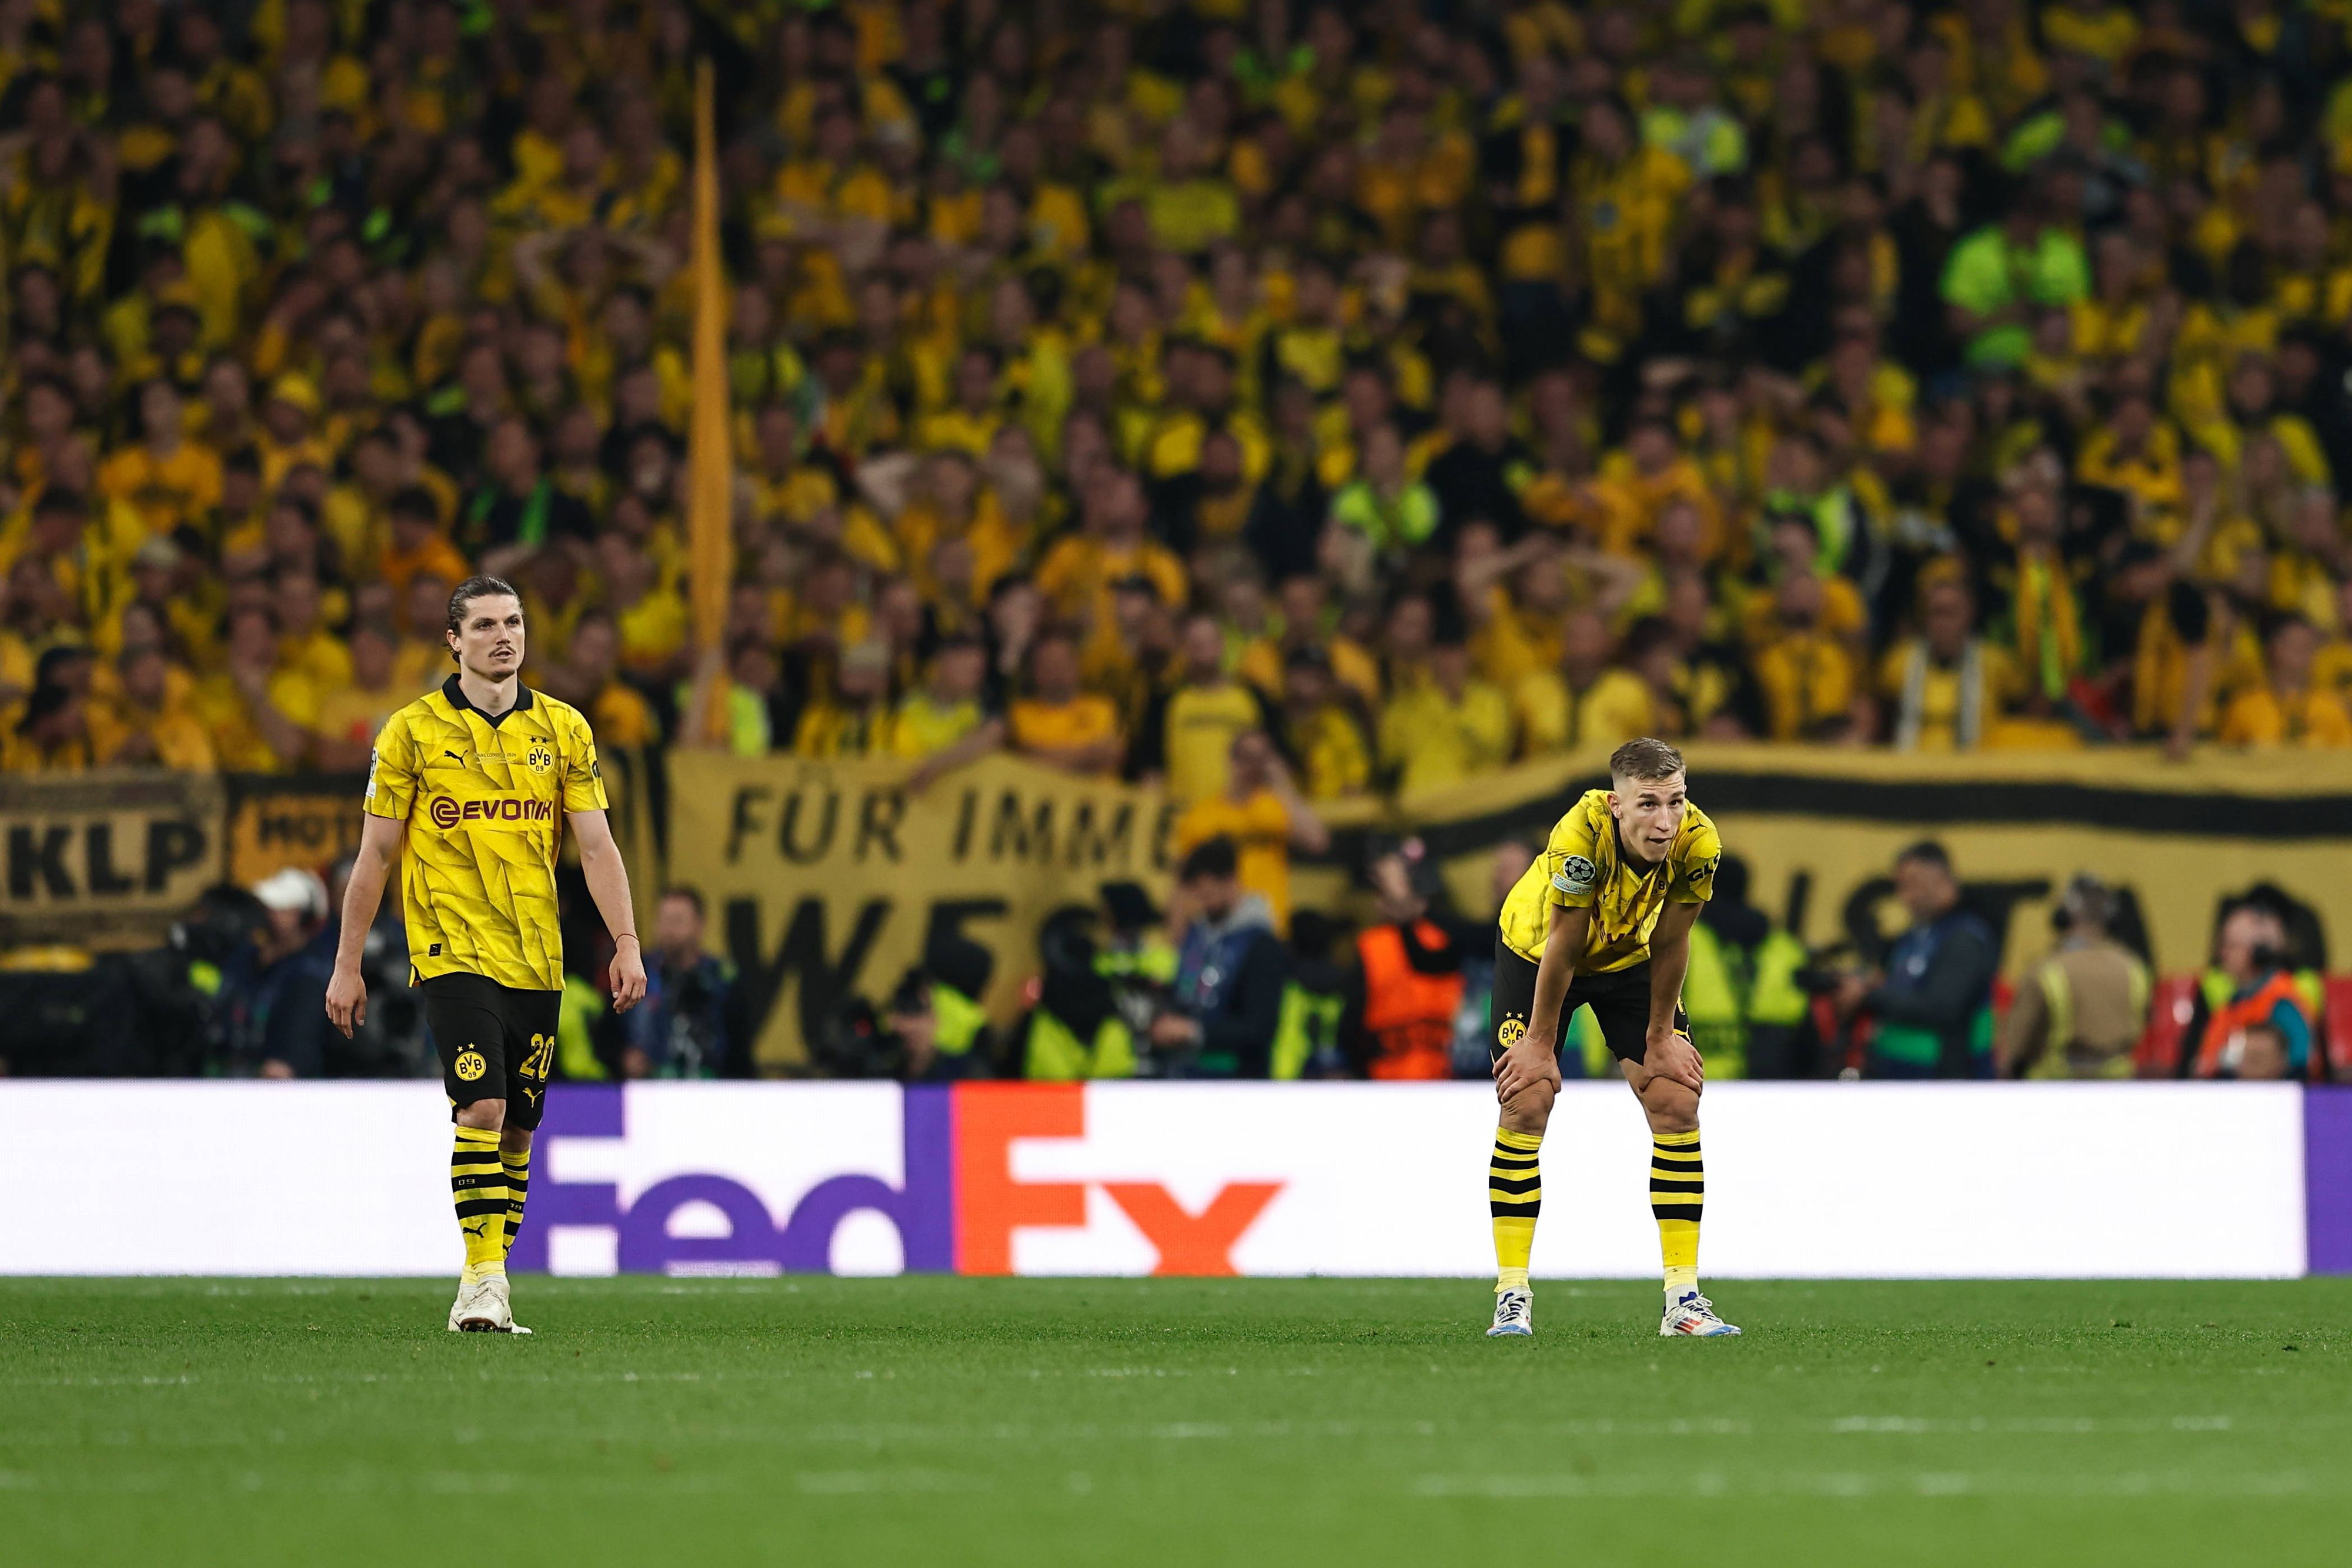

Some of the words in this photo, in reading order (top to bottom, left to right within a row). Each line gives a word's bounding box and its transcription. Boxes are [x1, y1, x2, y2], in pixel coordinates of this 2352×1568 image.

[529, 748, 551, 765] BVB
[463, 799, 553, 820] EVONIK
[8, 818, 207, 900] KLP
[1502, 1022, 1524, 1040] BVB
[459, 1055, 482, 1074] BVB
[519, 1033, 555, 1082] 20
